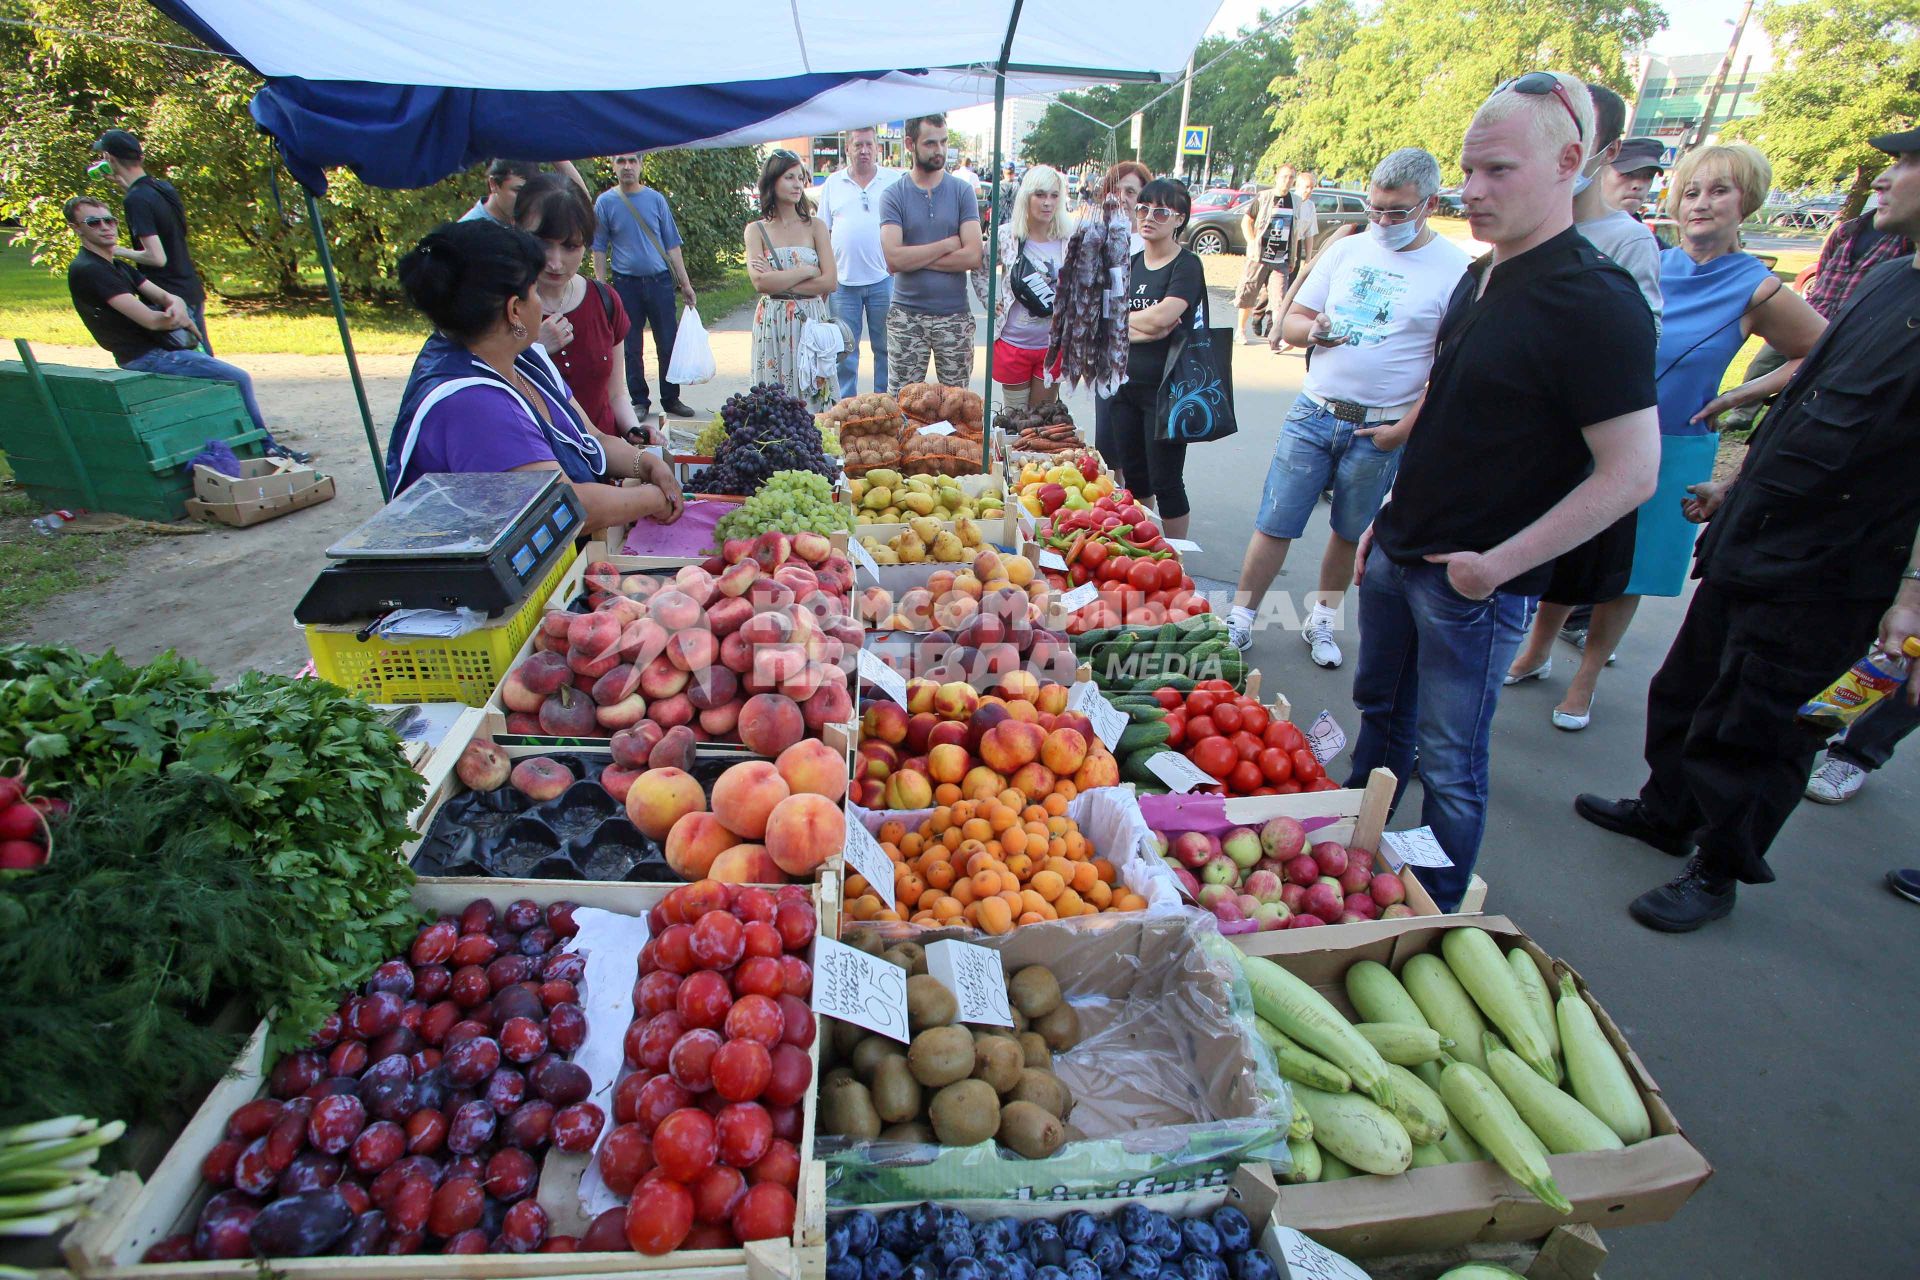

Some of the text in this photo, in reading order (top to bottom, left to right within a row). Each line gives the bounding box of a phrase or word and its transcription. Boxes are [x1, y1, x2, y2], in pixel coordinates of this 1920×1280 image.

[1135, 284, 1147, 294] Я
[1836, 687, 1861, 701] Lipton
[819, 948, 837, 1011] Слива
